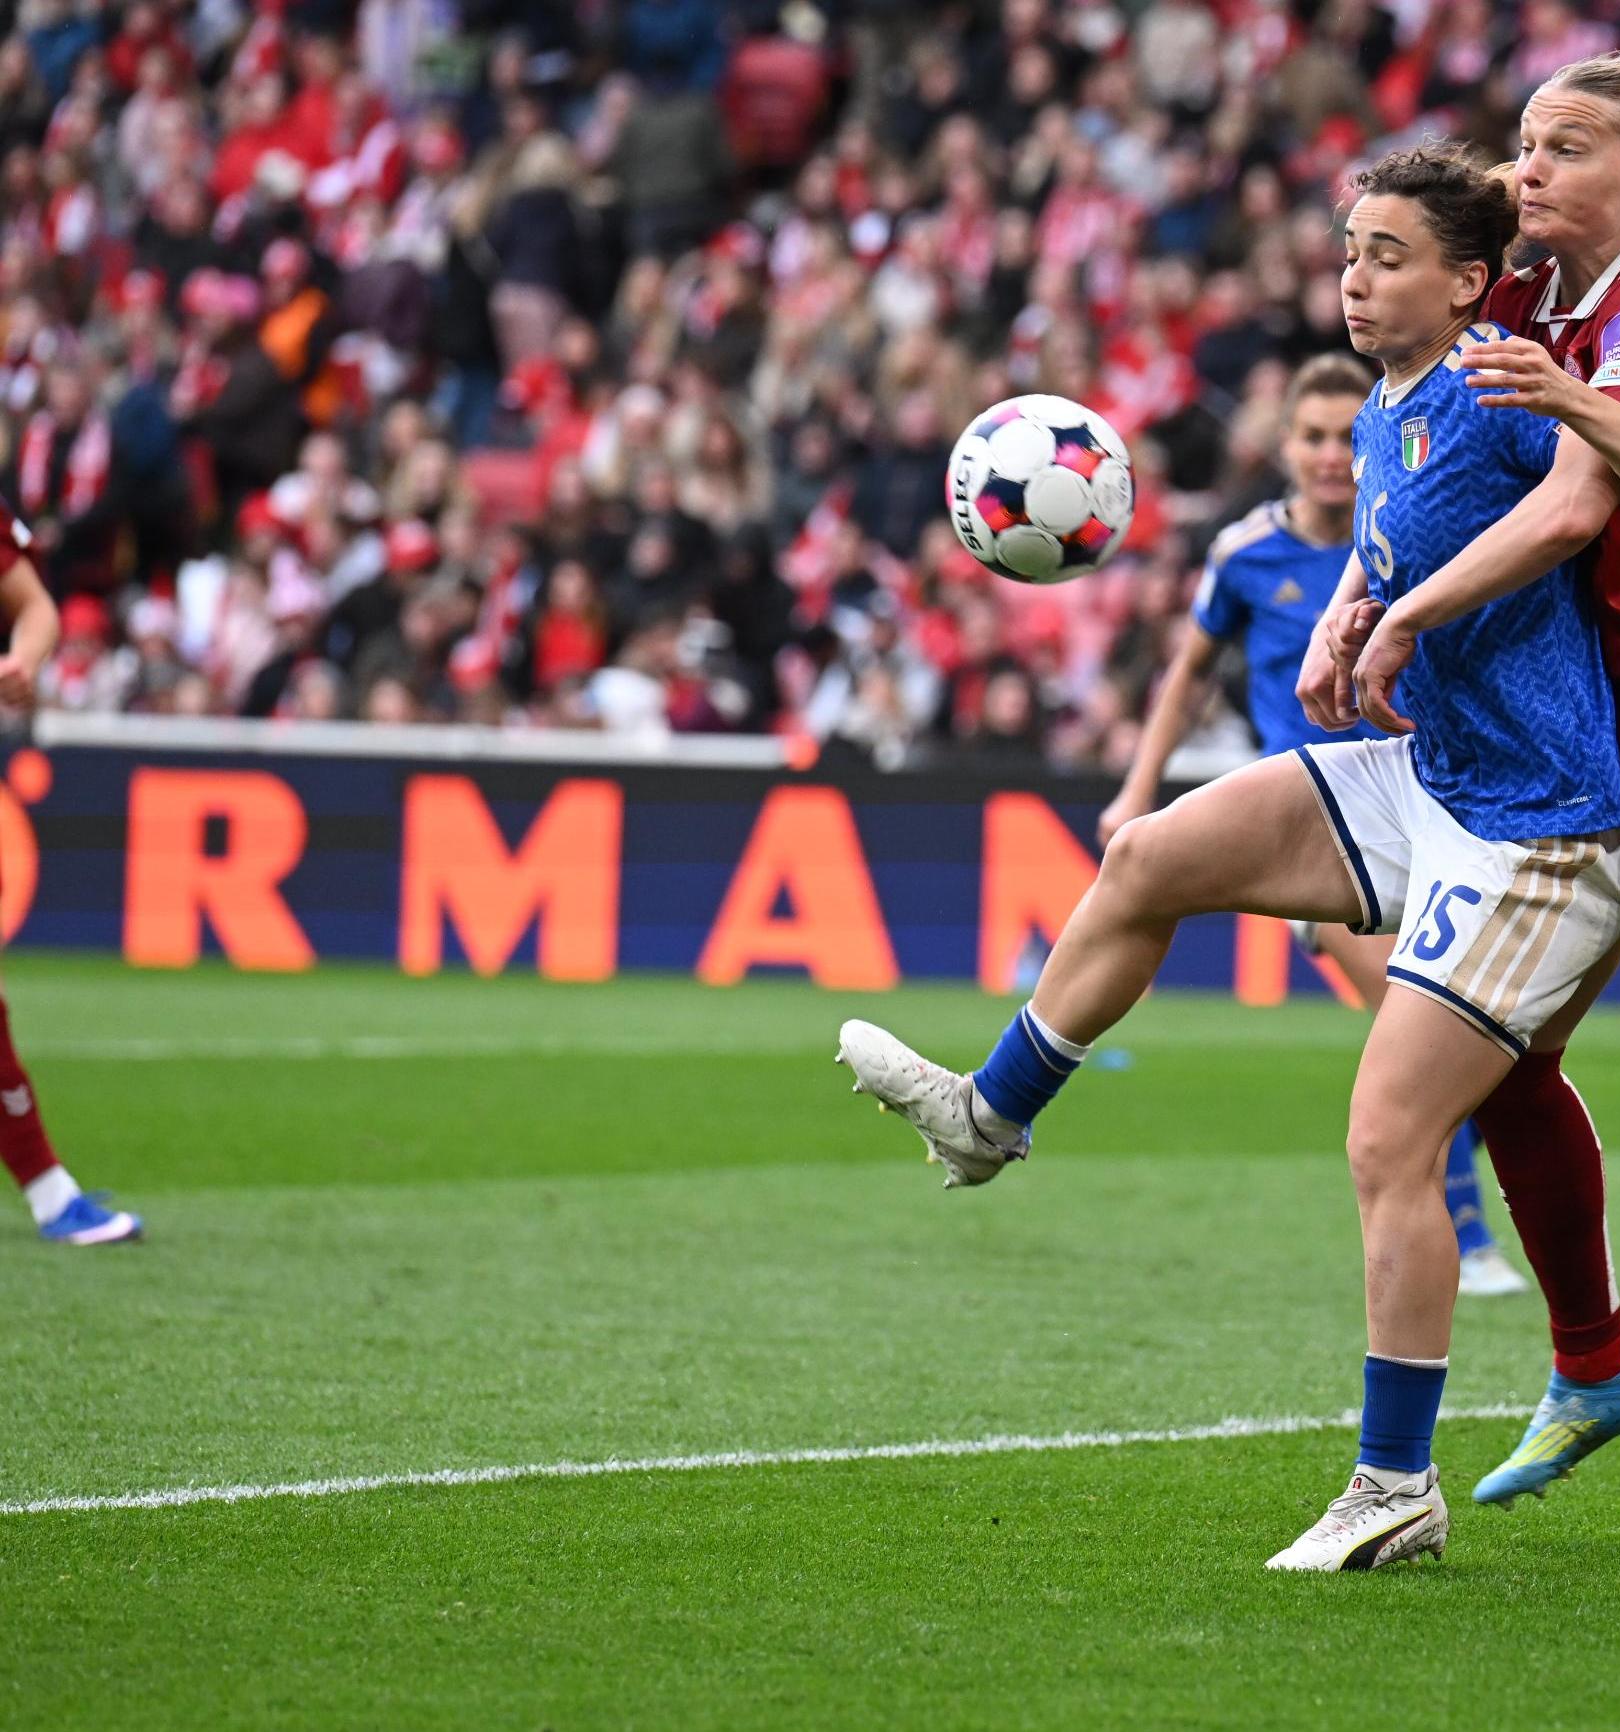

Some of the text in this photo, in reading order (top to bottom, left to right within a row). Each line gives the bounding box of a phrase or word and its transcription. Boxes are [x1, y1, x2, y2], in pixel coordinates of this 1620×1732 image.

[1404, 420, 1426, 436] ITALIA
[1360, 490, 1394, 581] 15
[1398, 878, 1482, 962] 15
